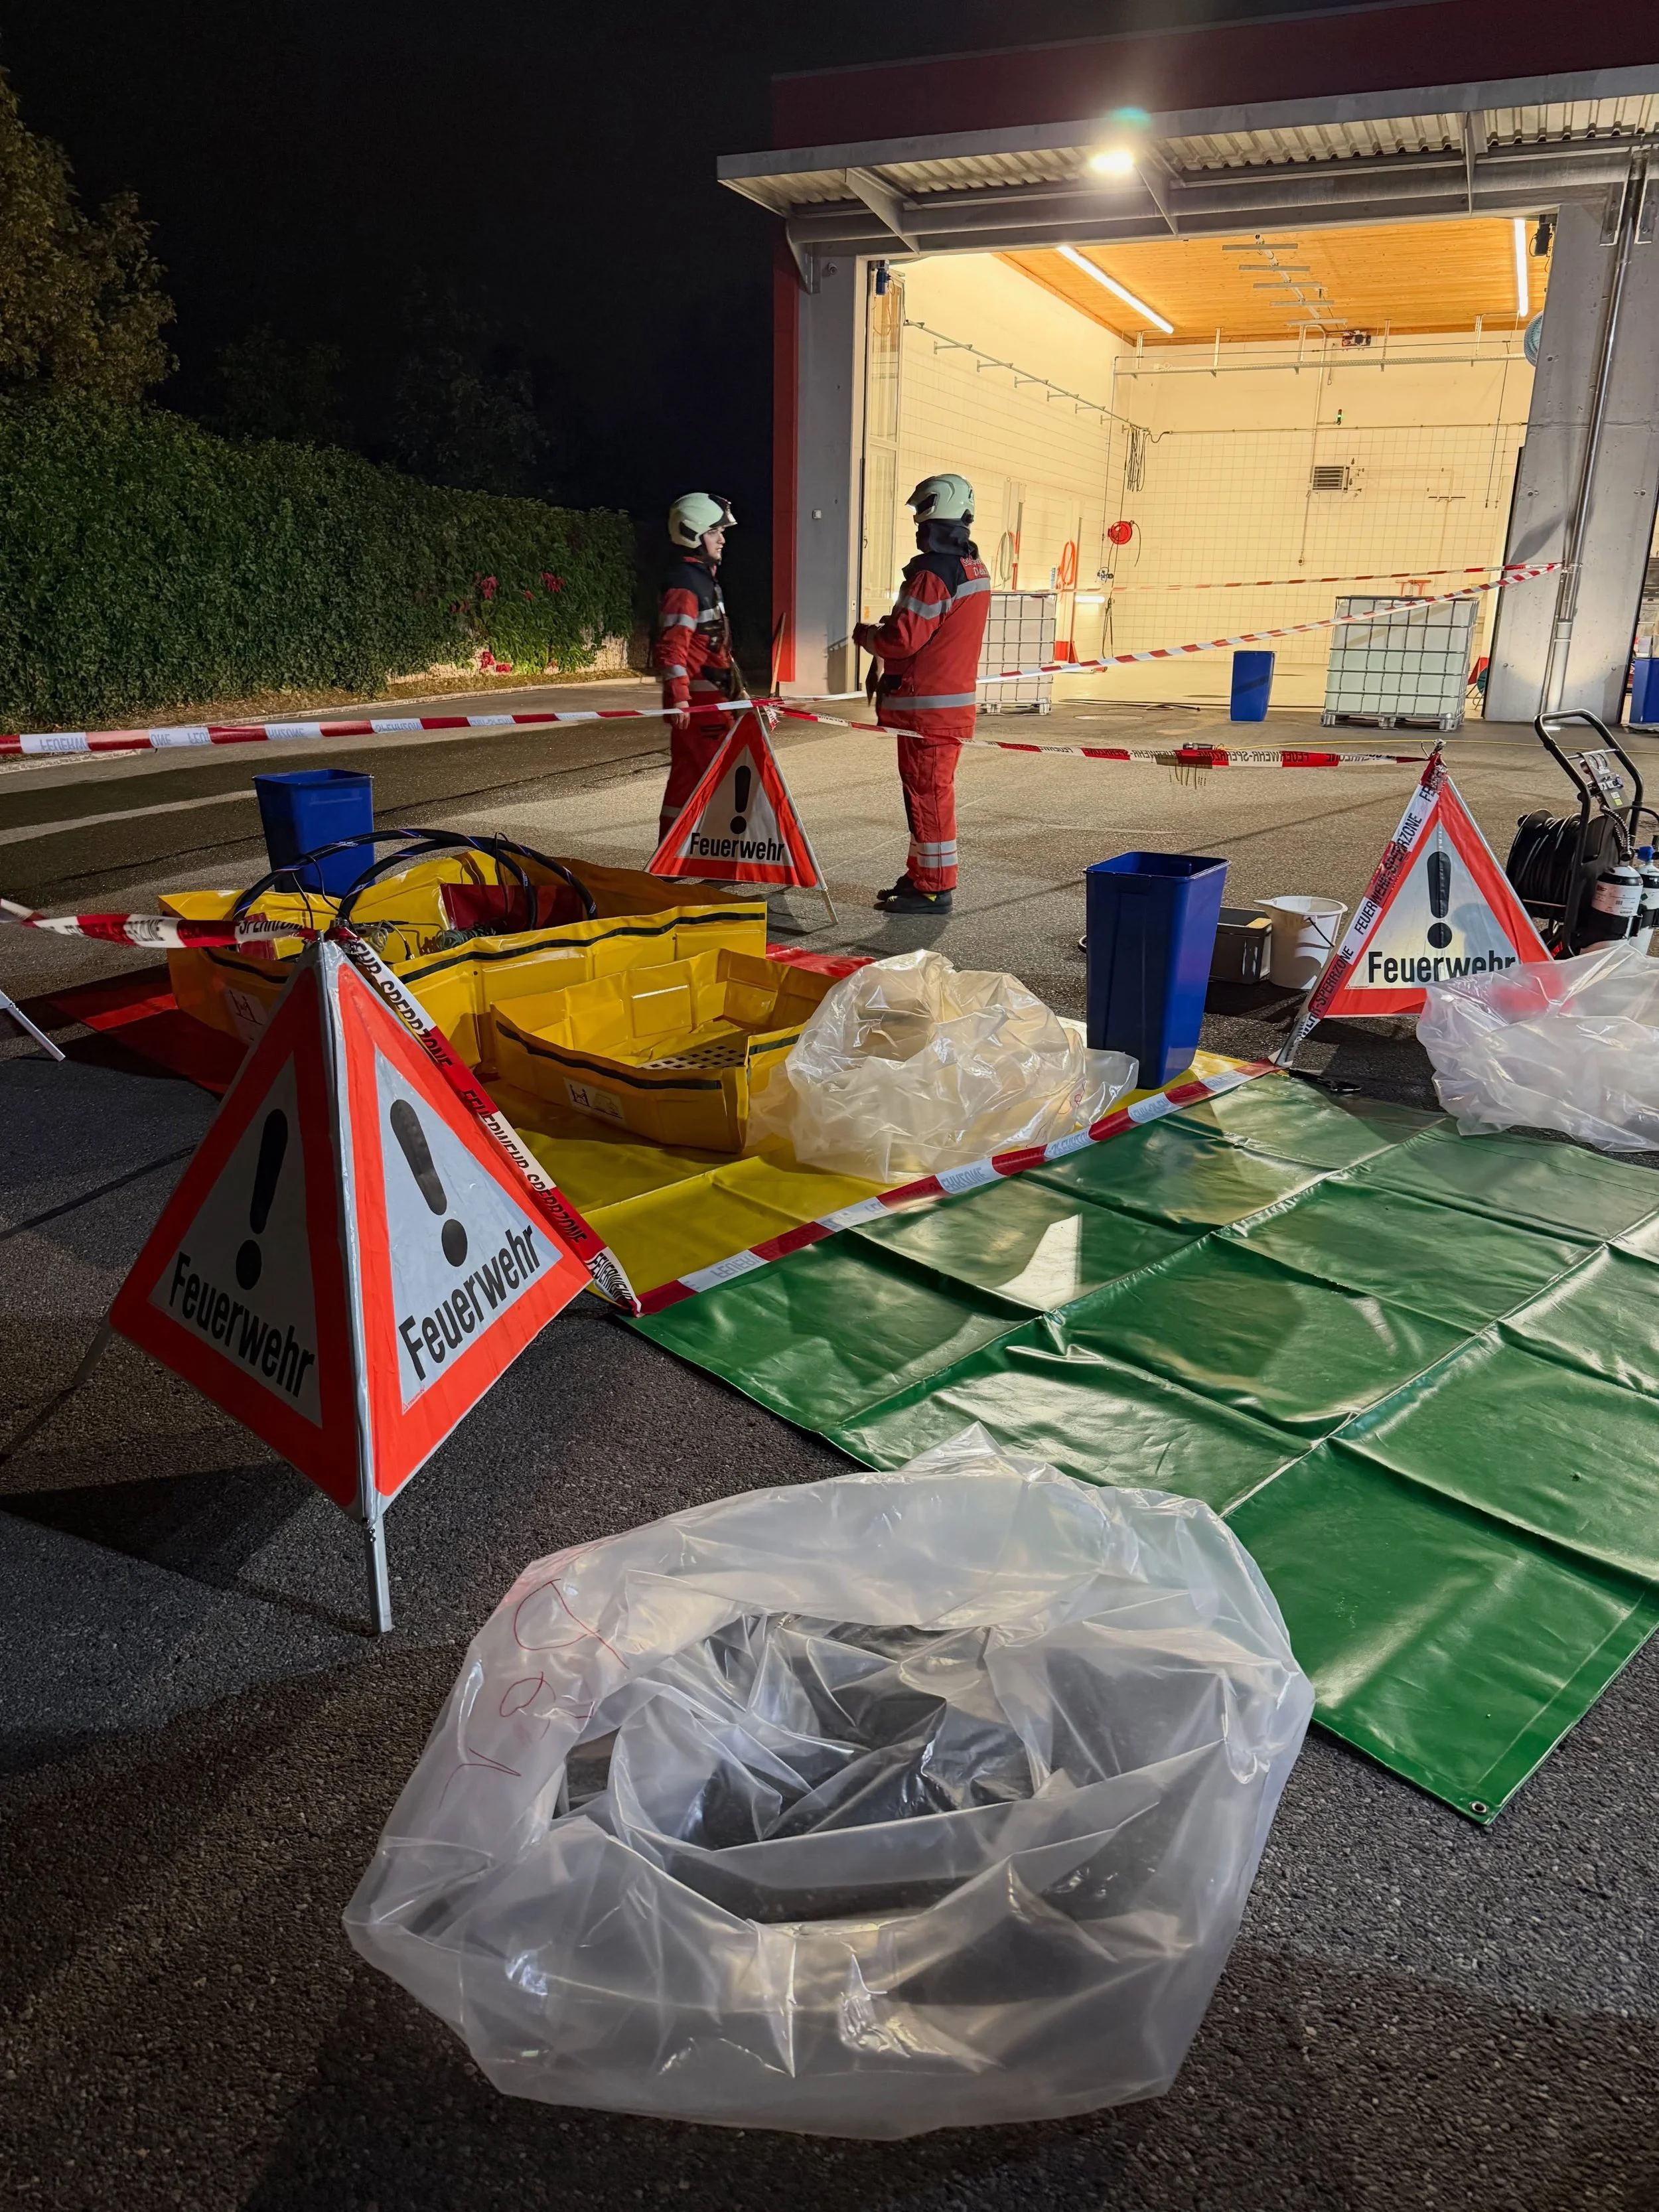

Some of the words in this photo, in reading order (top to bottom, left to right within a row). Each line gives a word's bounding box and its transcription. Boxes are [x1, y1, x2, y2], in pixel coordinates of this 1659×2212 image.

[690, 832, 785, 862] Feuerwehr
[169, 1252, 315, 1398] Feuerwehr
[399, 1225, 540, 1381] Feuerwehr
